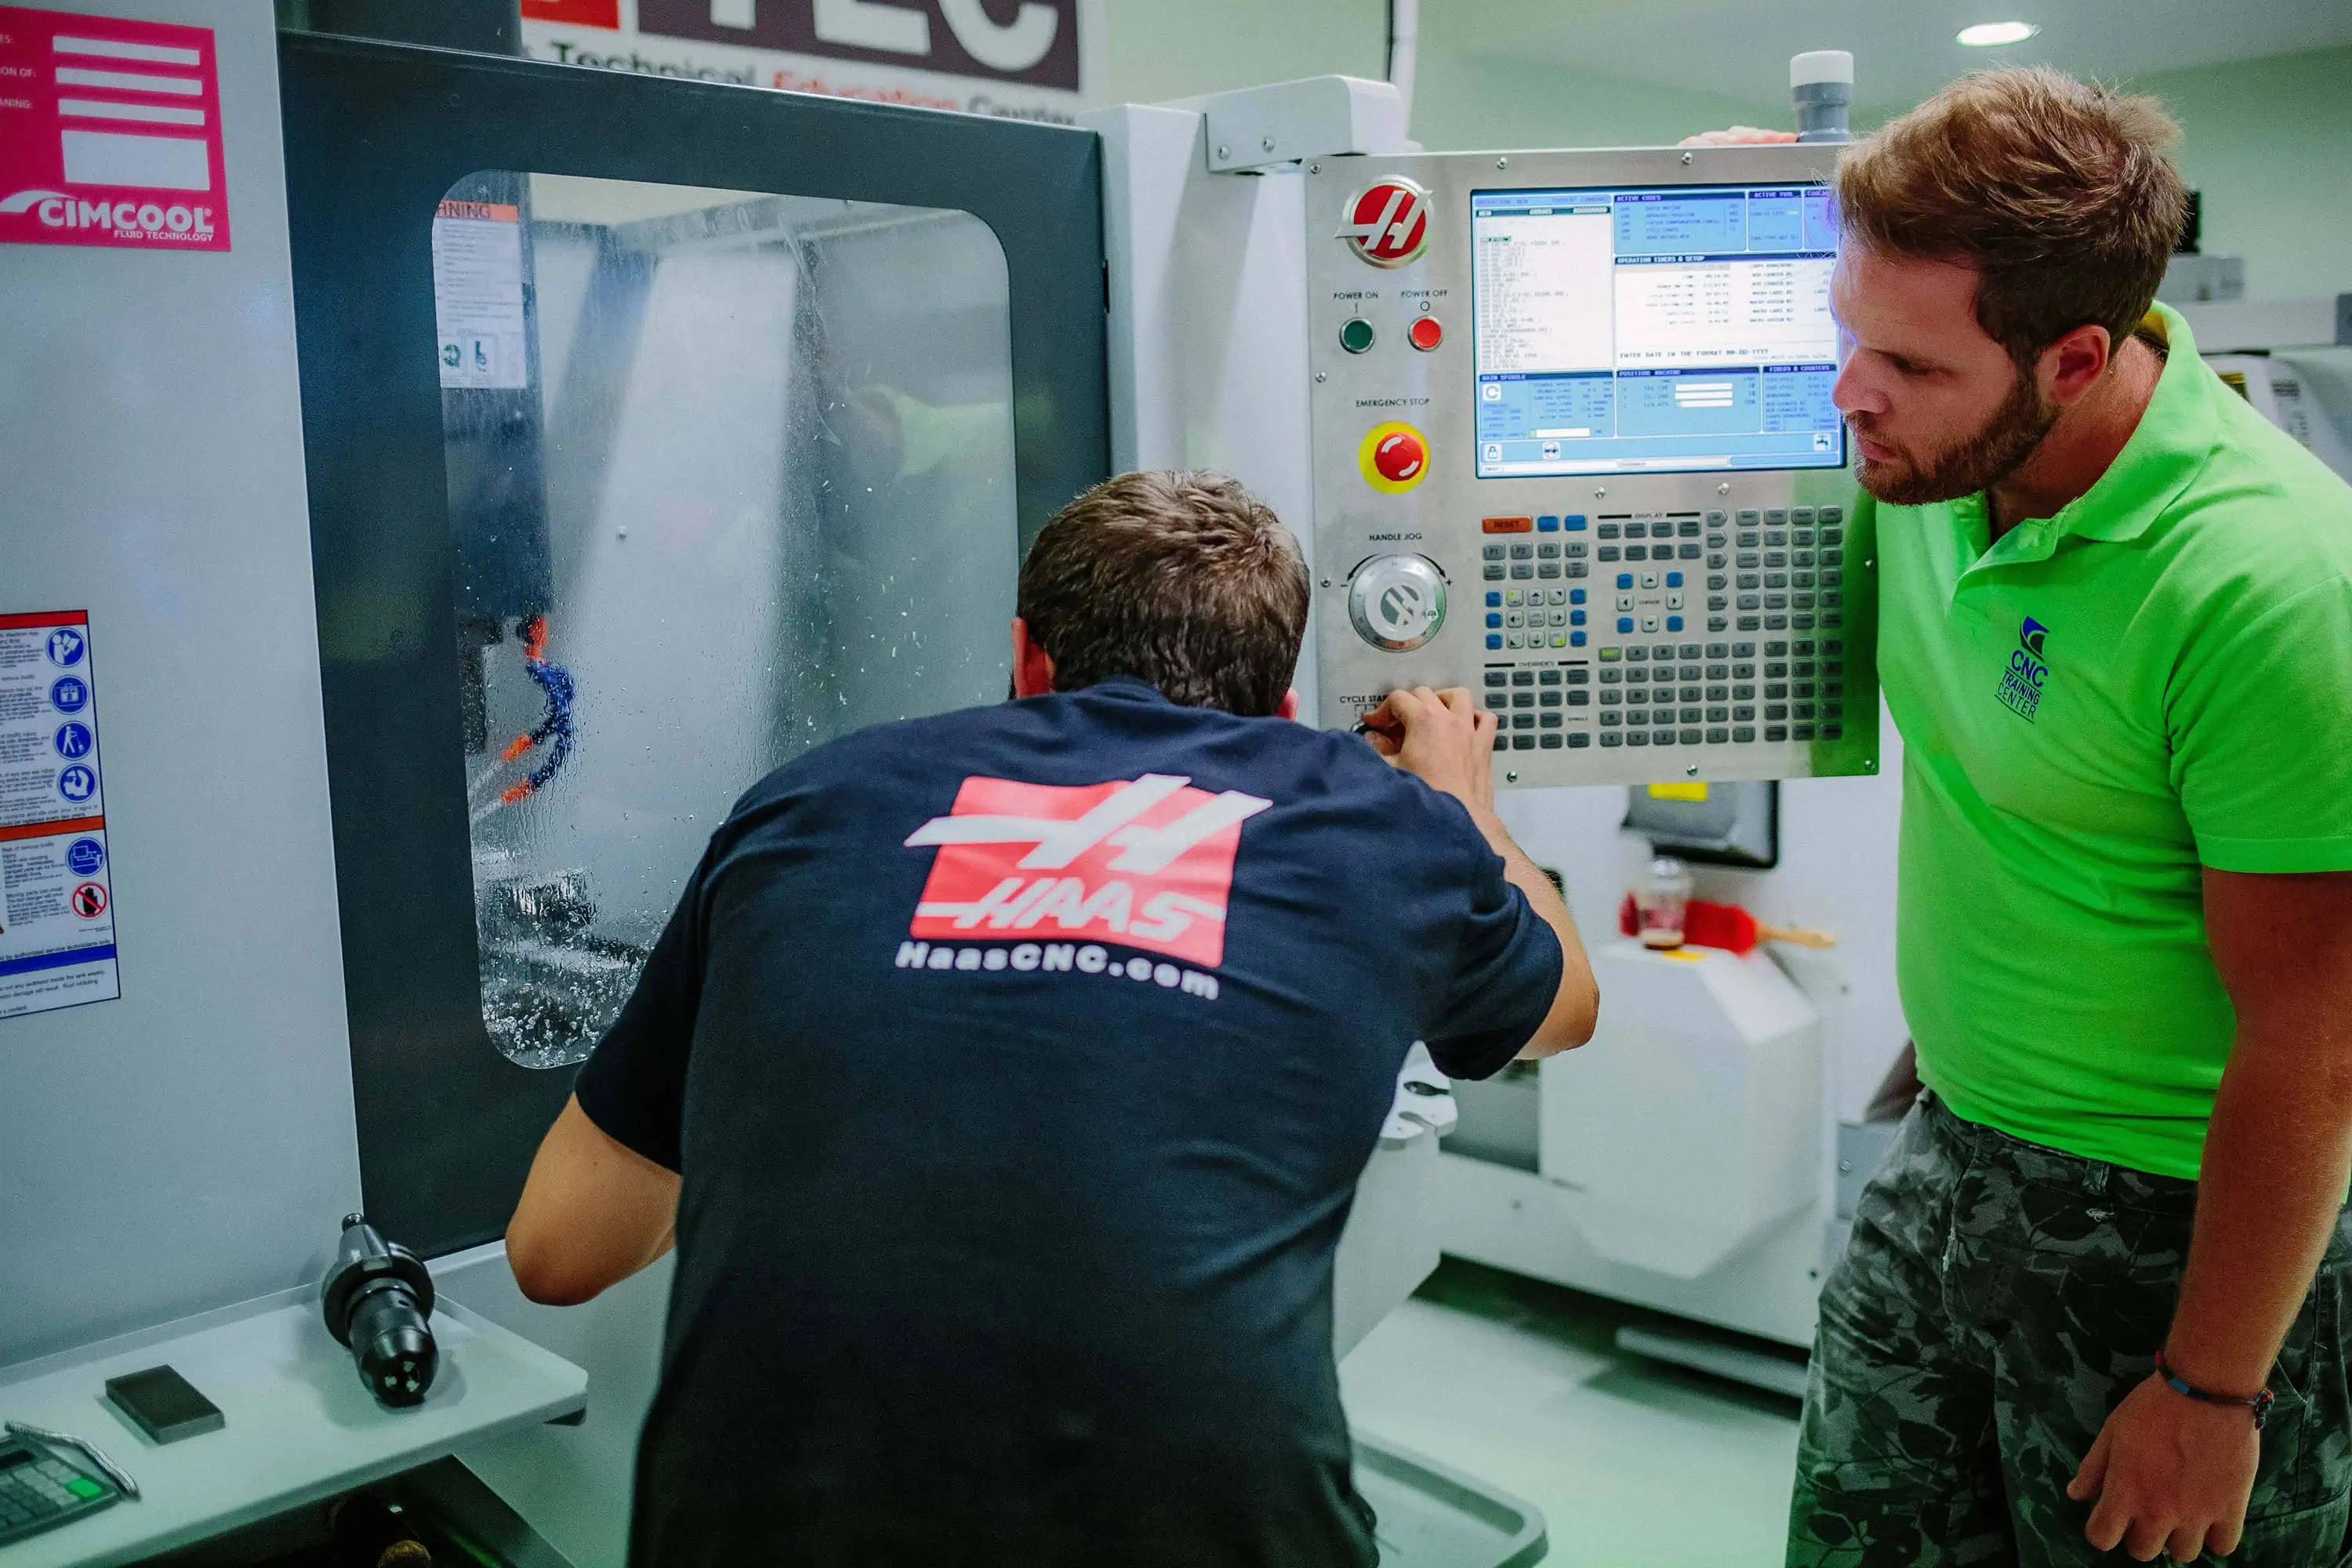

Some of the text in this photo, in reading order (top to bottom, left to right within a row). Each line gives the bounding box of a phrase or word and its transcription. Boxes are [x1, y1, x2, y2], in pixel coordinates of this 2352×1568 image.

[114, 230, 214, 242] FLUID TECHNOLOGY
[1410, 397, 1430, 406] STOP
[2011, 650, 2049, 688] CNC
[1369, 695, 1387, 703] STA
[1997, 682, 2036, 719] CENTER
[2002, 670, 2040, 706] TRAINING
[916, 877, 1225, 942] HAAS
[895, 942, 1219, 1000] HaasCNC.com
